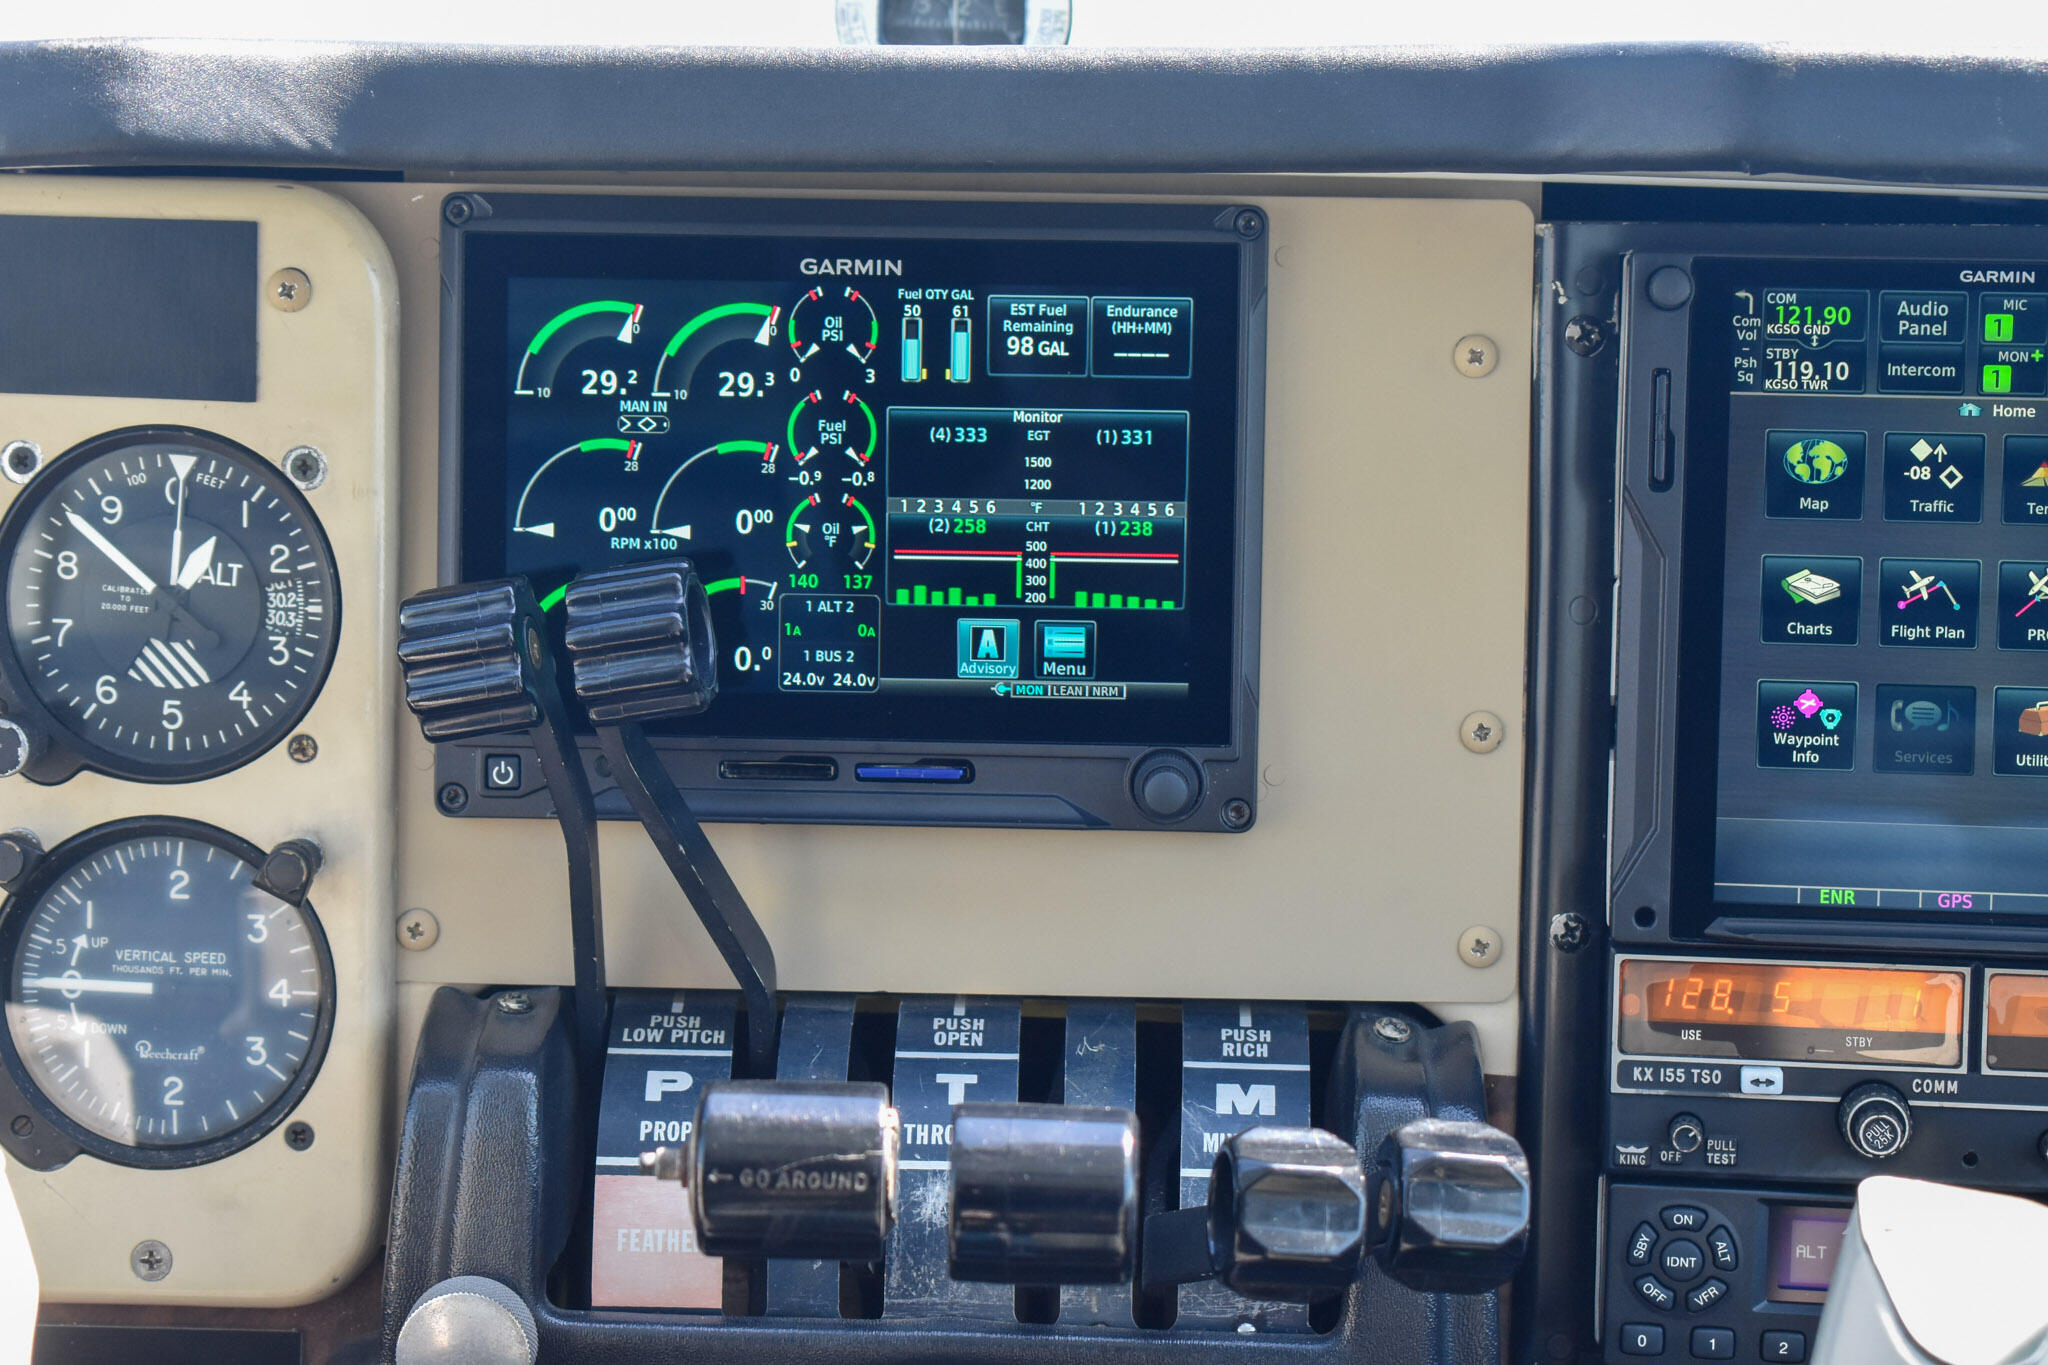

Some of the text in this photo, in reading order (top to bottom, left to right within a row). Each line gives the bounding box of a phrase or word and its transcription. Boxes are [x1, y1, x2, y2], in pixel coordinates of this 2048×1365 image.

[799, 257, 904, 276] GARMIN
[1959, 270, 2036, 284] GARMIN
[898, 289, 974, 301] Fuel QTY GAL
[1767, 293, 1796, 304] COM
[904, 305, 969, 317] 50 61
[1010, 304, 1067, 316] EST Fuel
[1107, 305, 1178, 318] Endurance
[1897, 301, 1949, 317] Audio
[2003, 299, 2028, 311] MIC
[1732, 315, 1761, 327] Com
[1776, 305, 1851, 325] 121.90
[824, 316, 842, 329] Oil
[1003, 320, 1074, 336] Remaining
[1111, 321, 1172, 336] (HH+MM)
[1899, 320, 1948, 336] Panel
[822, 329, 843, 342] PSI
[1737, 329, 1757, 341] Vol
[1767, 324, 1830, 336] KGSO GND
[1007, 336, 1070, 356] 98 GAL
[1766, 348, 1799, 360] STBY
[1998, 351, 2029, 363] MON
[1734, 357, 1757, 369] Psh
[789, 368, 876, 383] 0 3
[1737, 371, 1754, 384] Sq
[1774, 361, 1849, 381] 119.10
[1887, 363, 1956, 378] Intercom
[1765, 379, 1828, 391] KGSO TWR
[619, 400, 668, 413] MAN IN
[1993, 404, 2036, 418] Home
[1012, 411, 1063, 423] Monitor
[818, 419, 846, 432] Fuel
[821, 432, 843, 445] PSI
[929, 426, 988, 443] (4) 333
[1027, 430, 1050, 441] EGT
[1096, 429, 1153, 446] (1) 331
[1024, 457, 1052, 468] 1500
[126, 472, 147, 487] 100
[195, 473, 226, 490] FEET
[1024, 479, 1052, 490] 1200
[100, 495, 122, 525] 9
[1800, 497, 1829, 513] Map
[1910, 499, 1954, 514] Traffic
[822, 522, 840, 535] Oil
[928, 519, 987, 535] (2) 258
[1025, 521, 1050, 533] CHT
[1095, 520, 1153, 537] (1) 238
[611, 538, 678, 550] RPM x100
[1025, 541, 1047, 552] 500
[57, 551, 78, 580] 8
[269, 544, 291, 573] 2
[1025, 558, 1047, 569] 400
[199, 562, 244, 587] ALT
[789, 574, 873, 589] 140 137
[1025, 575, 1047, 586] 300
[267, 592, 297, 608] 30.2
[1025, 592, 1047, 603] 200
[816, 601, 843, 613] ALT
[846, 601, 854, 613] 2
[265, 610, 297, 628] 30.3
[52, 618, 73, 647] 7
[1787, 622, 1833, 636] Charts
[1891, 625, 1965, 640] Flight Plan
[268, 636, 290, 666] 3
[815, 650, 842, 663] BUS
[846, 650, 854, 663] 2
[960, 662, 1017, 677] Advisory
[1043, 662, 1087, 676] Menu
[95, 675, 118, 705] 6
[229, 680, 252, 709] 4
[1016, 684, 1043, 695] MON
[1053, 685, 1083, 697] LEAN
[1092, 686, 1118, 697] NRM
[162, 700, 184, 730] 5
[1773, 733, 1840, 749] Waypoint
[1792, 750, 1820, 763] Info
[1894, 751, 1953, 764] Services
[169, 870, 190, 900] 2
[1820, 889, 1856, 905] ENR
[1937, 893, 1973, 909] GPS
[247, 914, 268, 943] 3
[91, 937, 109, 948] UP
[115, 949, 226, 965] VERTICAL SPEED
[112, 964, 232, 978] THOUSANDS FT. PER MIN.
[268, 979, 292, 1007] 4
[650, 1015, 702, 1029] PUSH
[933, 1017, 985, 1031] PUSH
[91, 1024, 128, 1035] DOWN
[622, 1028, 726, 1045] LOW PITCH
[1221, 1028, 1271, 1043] PUSH
[1681, 1029, 1702, 1041] USE
[934, 1031, 983, 1047] OPEN
[1845, 1036, 1873, 1048] STBY
[246, 1036, 267, 1065] 3
[1222, 1042, 1268, 1058] RICH
[1633, 1066, 1722, 1084] KX 155 TSO
[163, 1076, 184, 1106] 2
[645, 1070, 694, 1102] P
[936, 1073, 978, 1105] T
[1912, 1079, 1958, 1094] COMM
[1215, 1083, 1276, 1116] M
[1865, 1120, 1890, 1143] PULL
[1707, 1139, 1736, 1151] PULL
[1874, 1130, 1895, 1150] 25K
[1619, 1154, 1647, 1166] KING
[1660, 1151, 1682, 1163] OFF
[1707, 1153, 1736, 1165] TEST
[739, 1169, 870, 1192] GO AROUND
[1673, 1213, 1693, 1225] ON
[1633, 1233, 1650, 1259] SBY
[1715, 1240, 1731, 1263] ALT
[1796, 1245, 1827, 1259] ALT
[1666, 1257, 1696, 1269] IDNT
[1642, 1283, 1668, 1303] OFF
[1694, 1286, 1719, 1307] VFR
[1637, 1334, 1647, 1347] 0
[1779, 1342, 1788, 1354] 2
